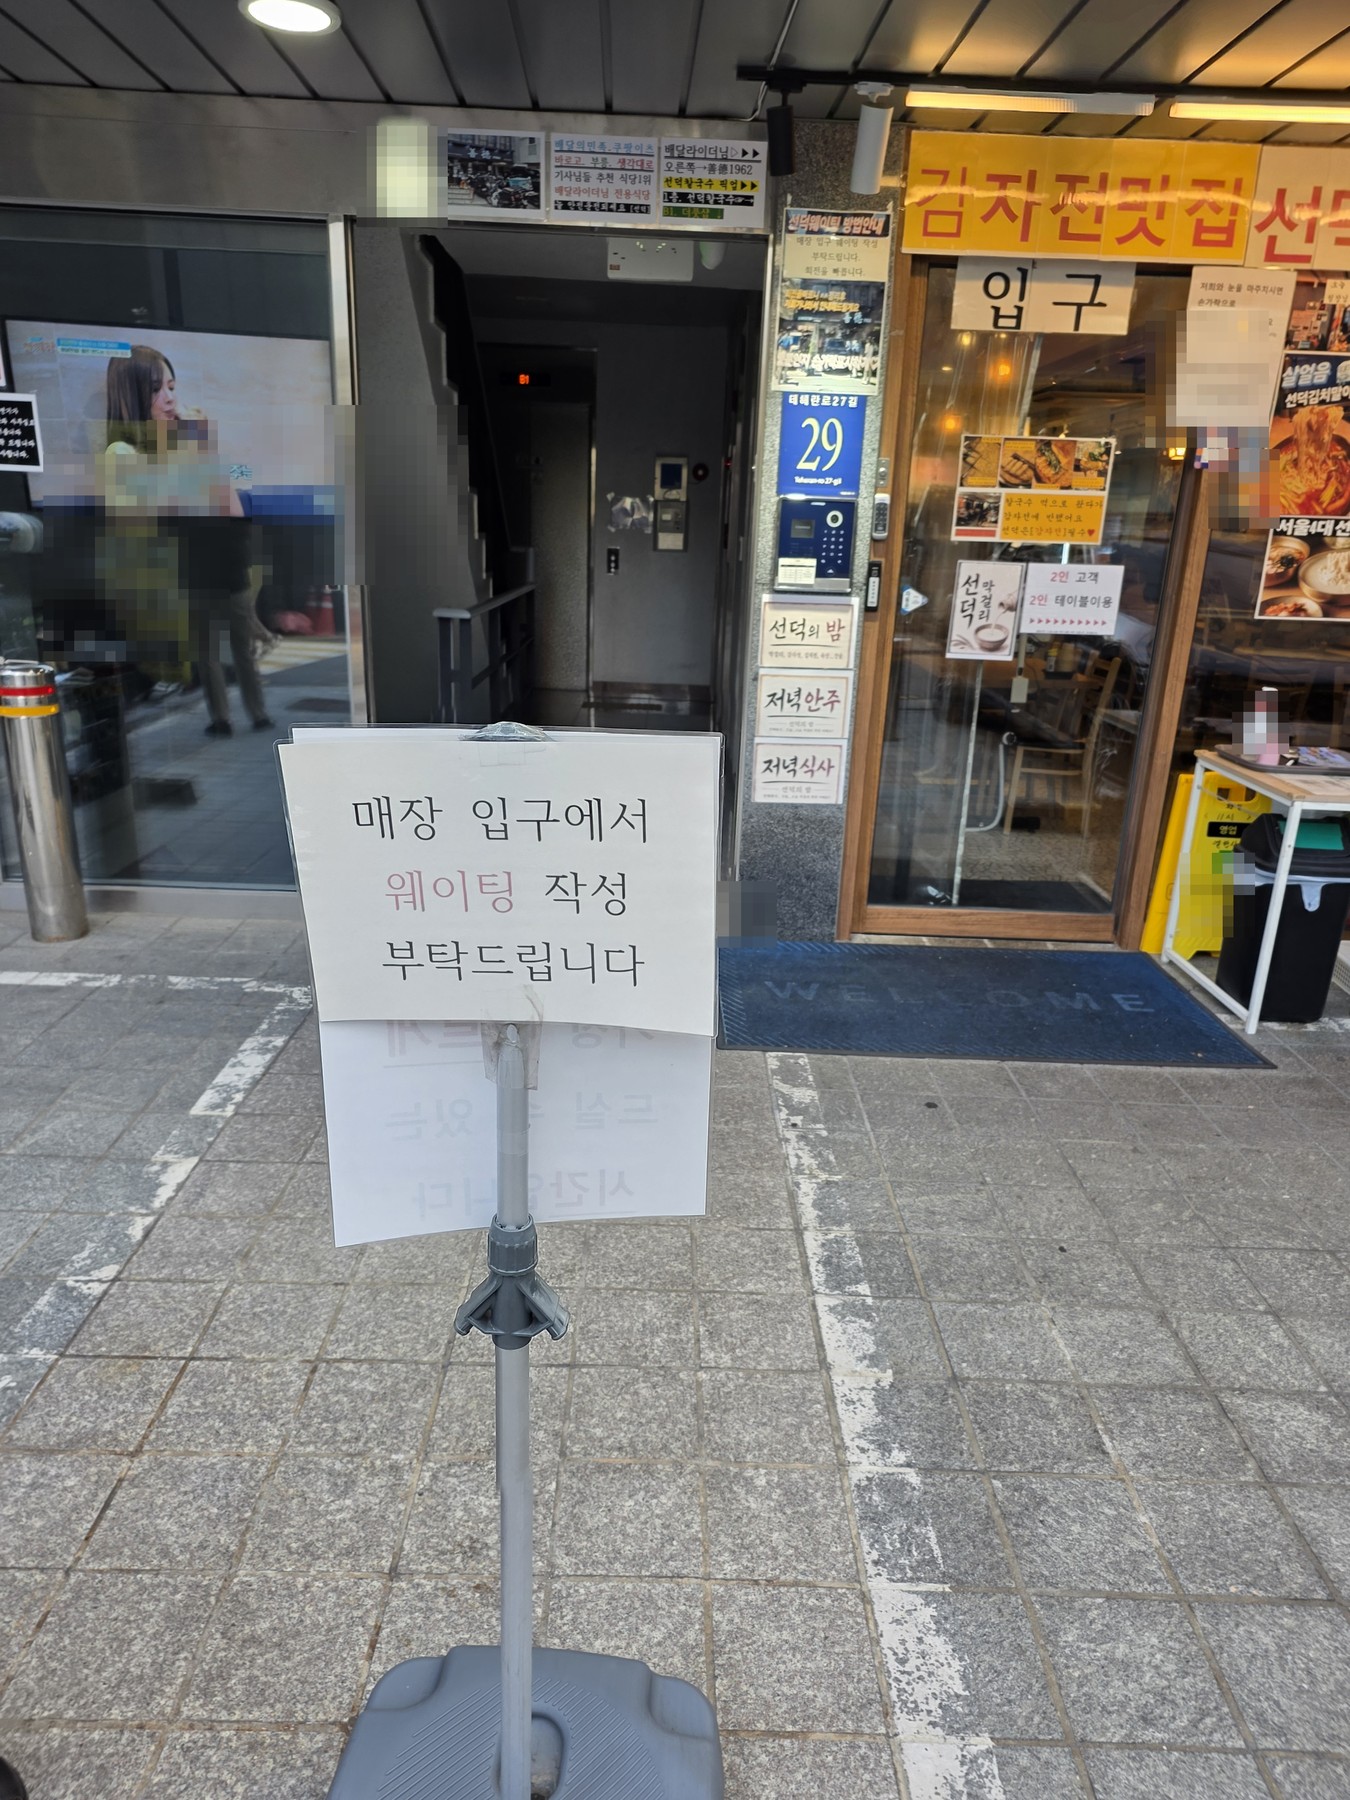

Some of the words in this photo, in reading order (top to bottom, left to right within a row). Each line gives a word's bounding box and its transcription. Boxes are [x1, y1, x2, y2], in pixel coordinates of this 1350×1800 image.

[664, 144, 729, 159] 배달라이더님
[554, 171, 592, 183] 기사님들
[596, 173, 615, 184] 추천
[619, 174, 651, 185] 식당1위
[554, 186, 609, 199] 배달라이더님
[614, 189, 650, 201] 전용식당
[843, 215, 886, 235] 방법안내
[1200, 282, 1224, 291] 저희와
[1227, 283, 1243, 293] 눈을
[1246, 284, 1284, 296] 마주치시면
[1281, 361, 1332, 390] 살얼음
[796, 417, 844, 472] 29
[1050, 571, 1069, 583] 2인
[1075, 572, 1099, 584] 고객
[960, 573, 980, 629] 선덕
[978, 580, 996, 622] 막걸리
[1029, 594, 1048, 606] 2인
[1054, 595, 1113, 609] 테이블이용
[769, 617, 820, 641] 선덕의
[826, 618, 846, 642] 밤
[764, 686, 841, 713] 저녁안주
[761, 755, 836, 778] 저녁식사
[351, 795, 444, 841] 매장
[471, 796, 648, 843] 입구에서
[384, 869, 515, 914] 웨이팅
[544, 871, 628, 917] 작성
[382, 940, 646, 988] 부탁드립니다
